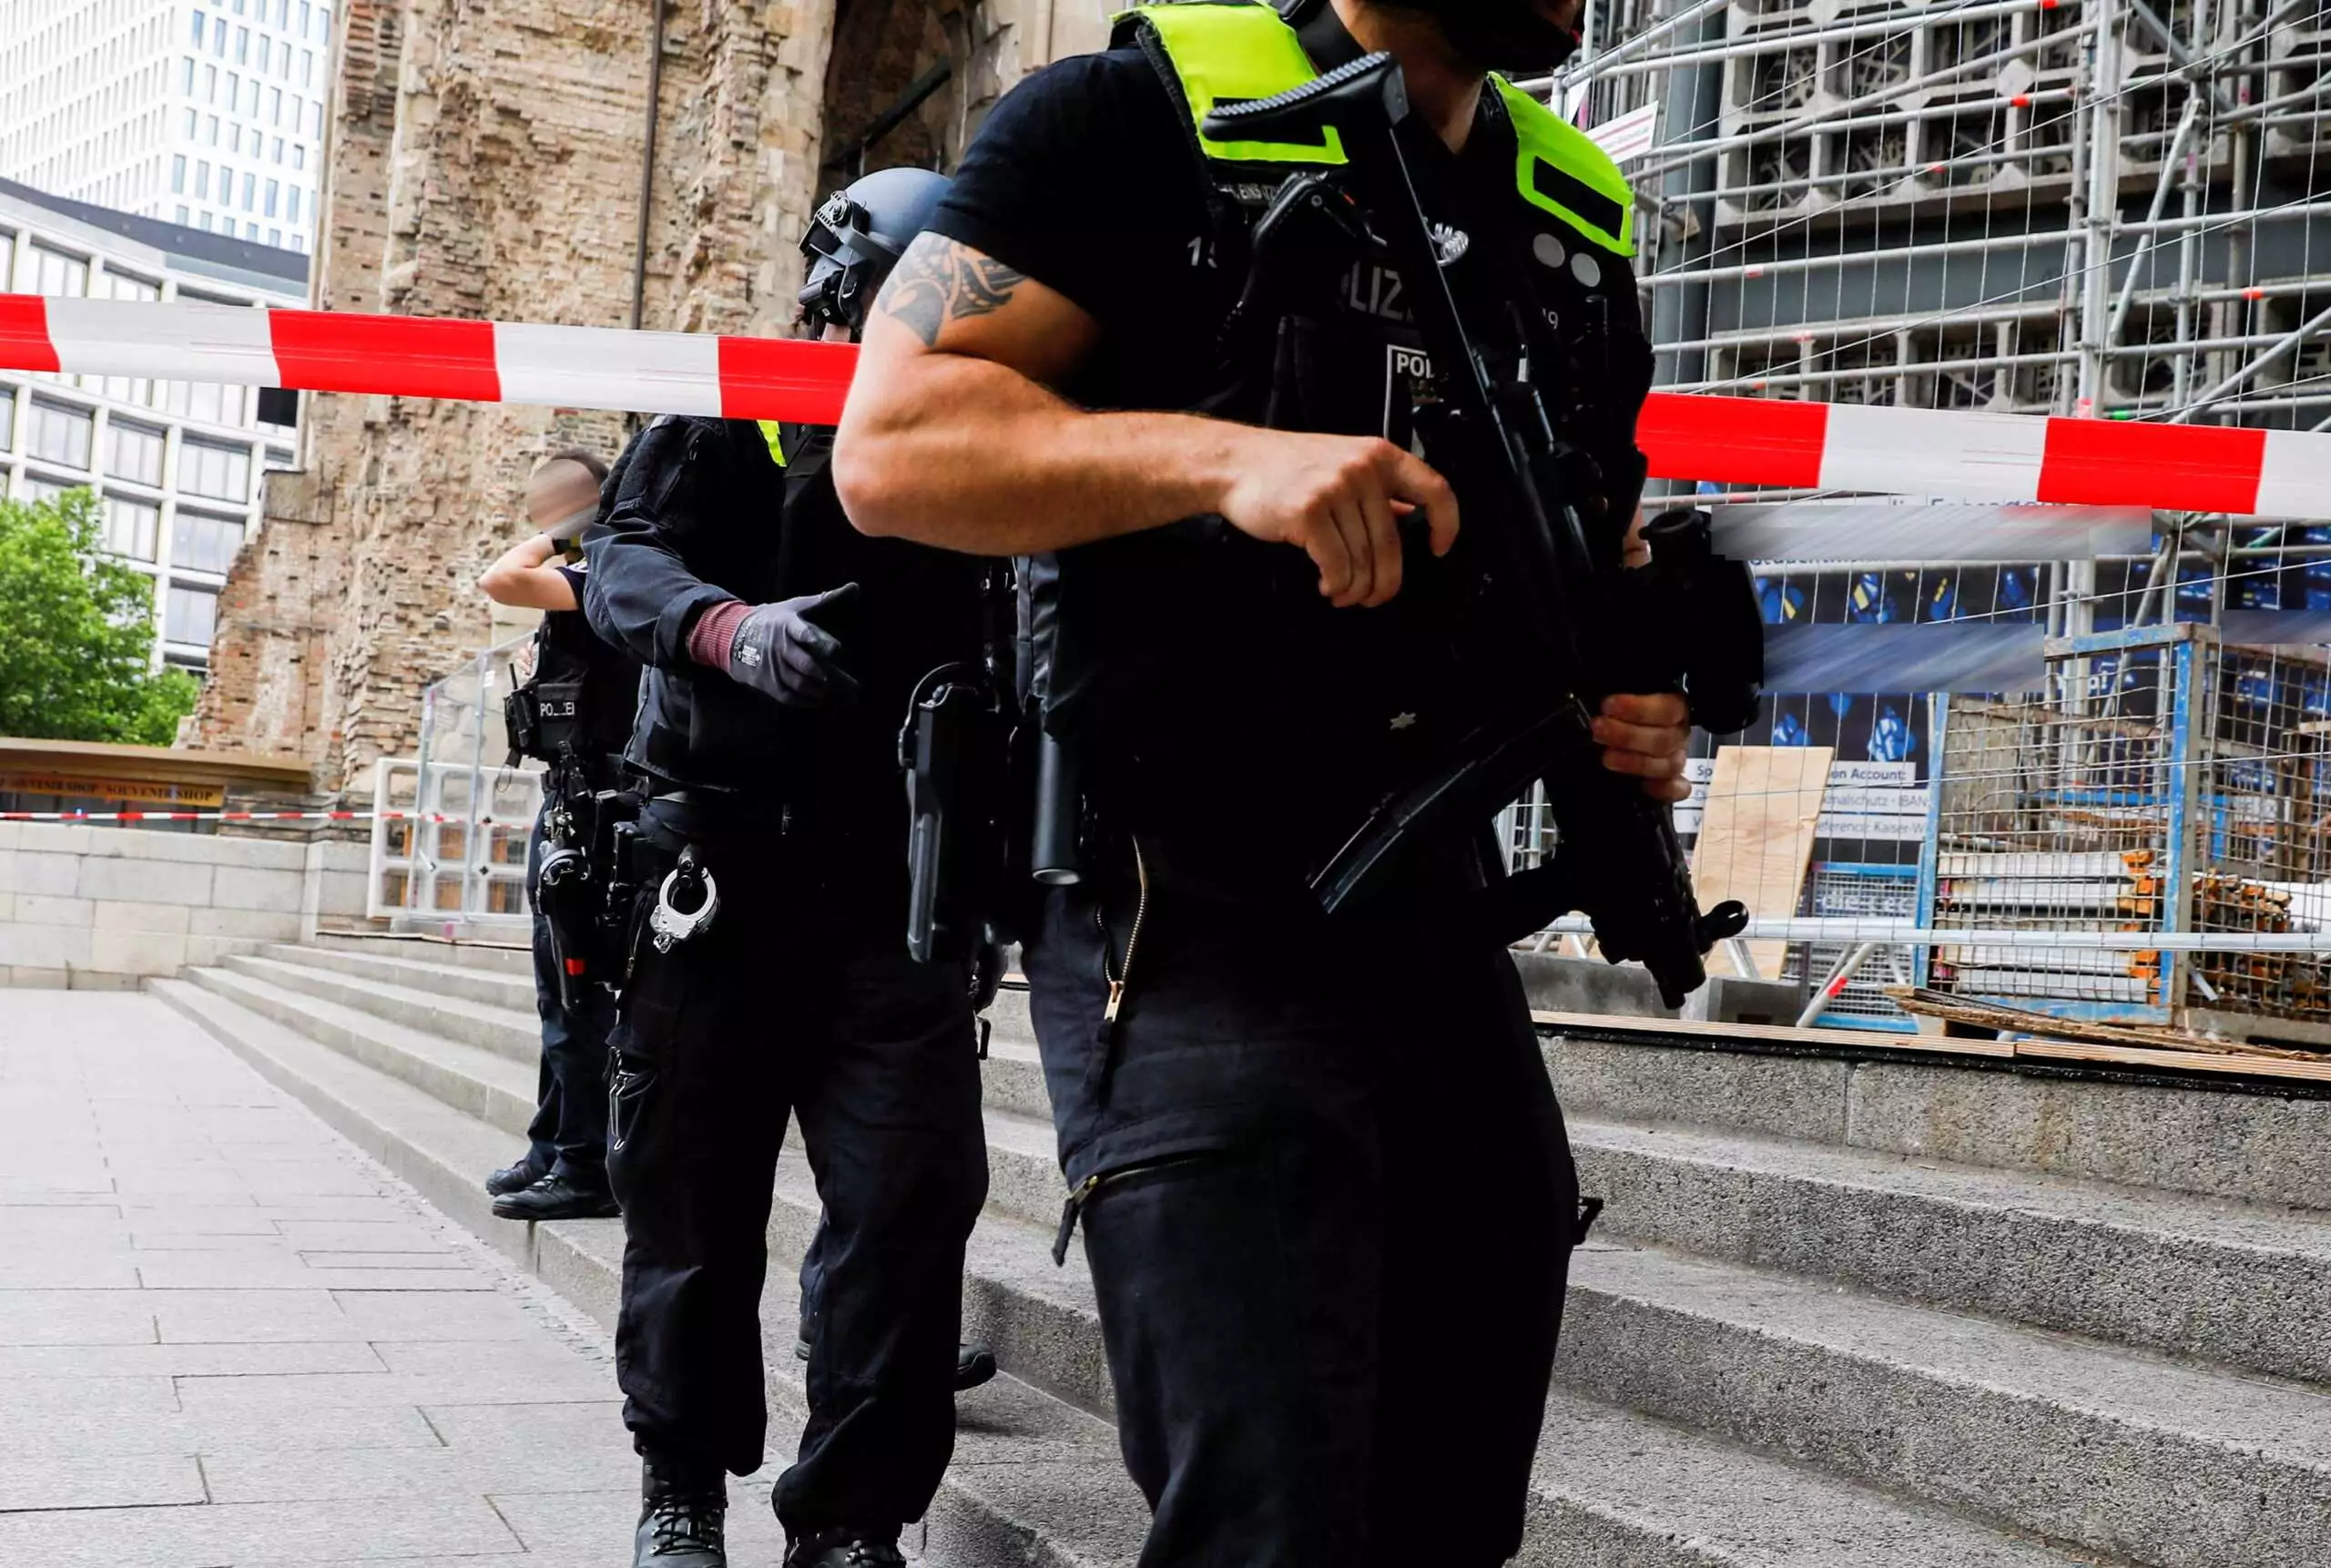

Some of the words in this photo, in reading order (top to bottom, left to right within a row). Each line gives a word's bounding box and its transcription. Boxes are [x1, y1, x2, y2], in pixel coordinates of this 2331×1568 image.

[1187, 236, 1218, 269] 1
[1396, 351, 1436, 379] POL
[1696, 765, 1713, 779] Sp
[175, 788, 214, 801] SHOP
